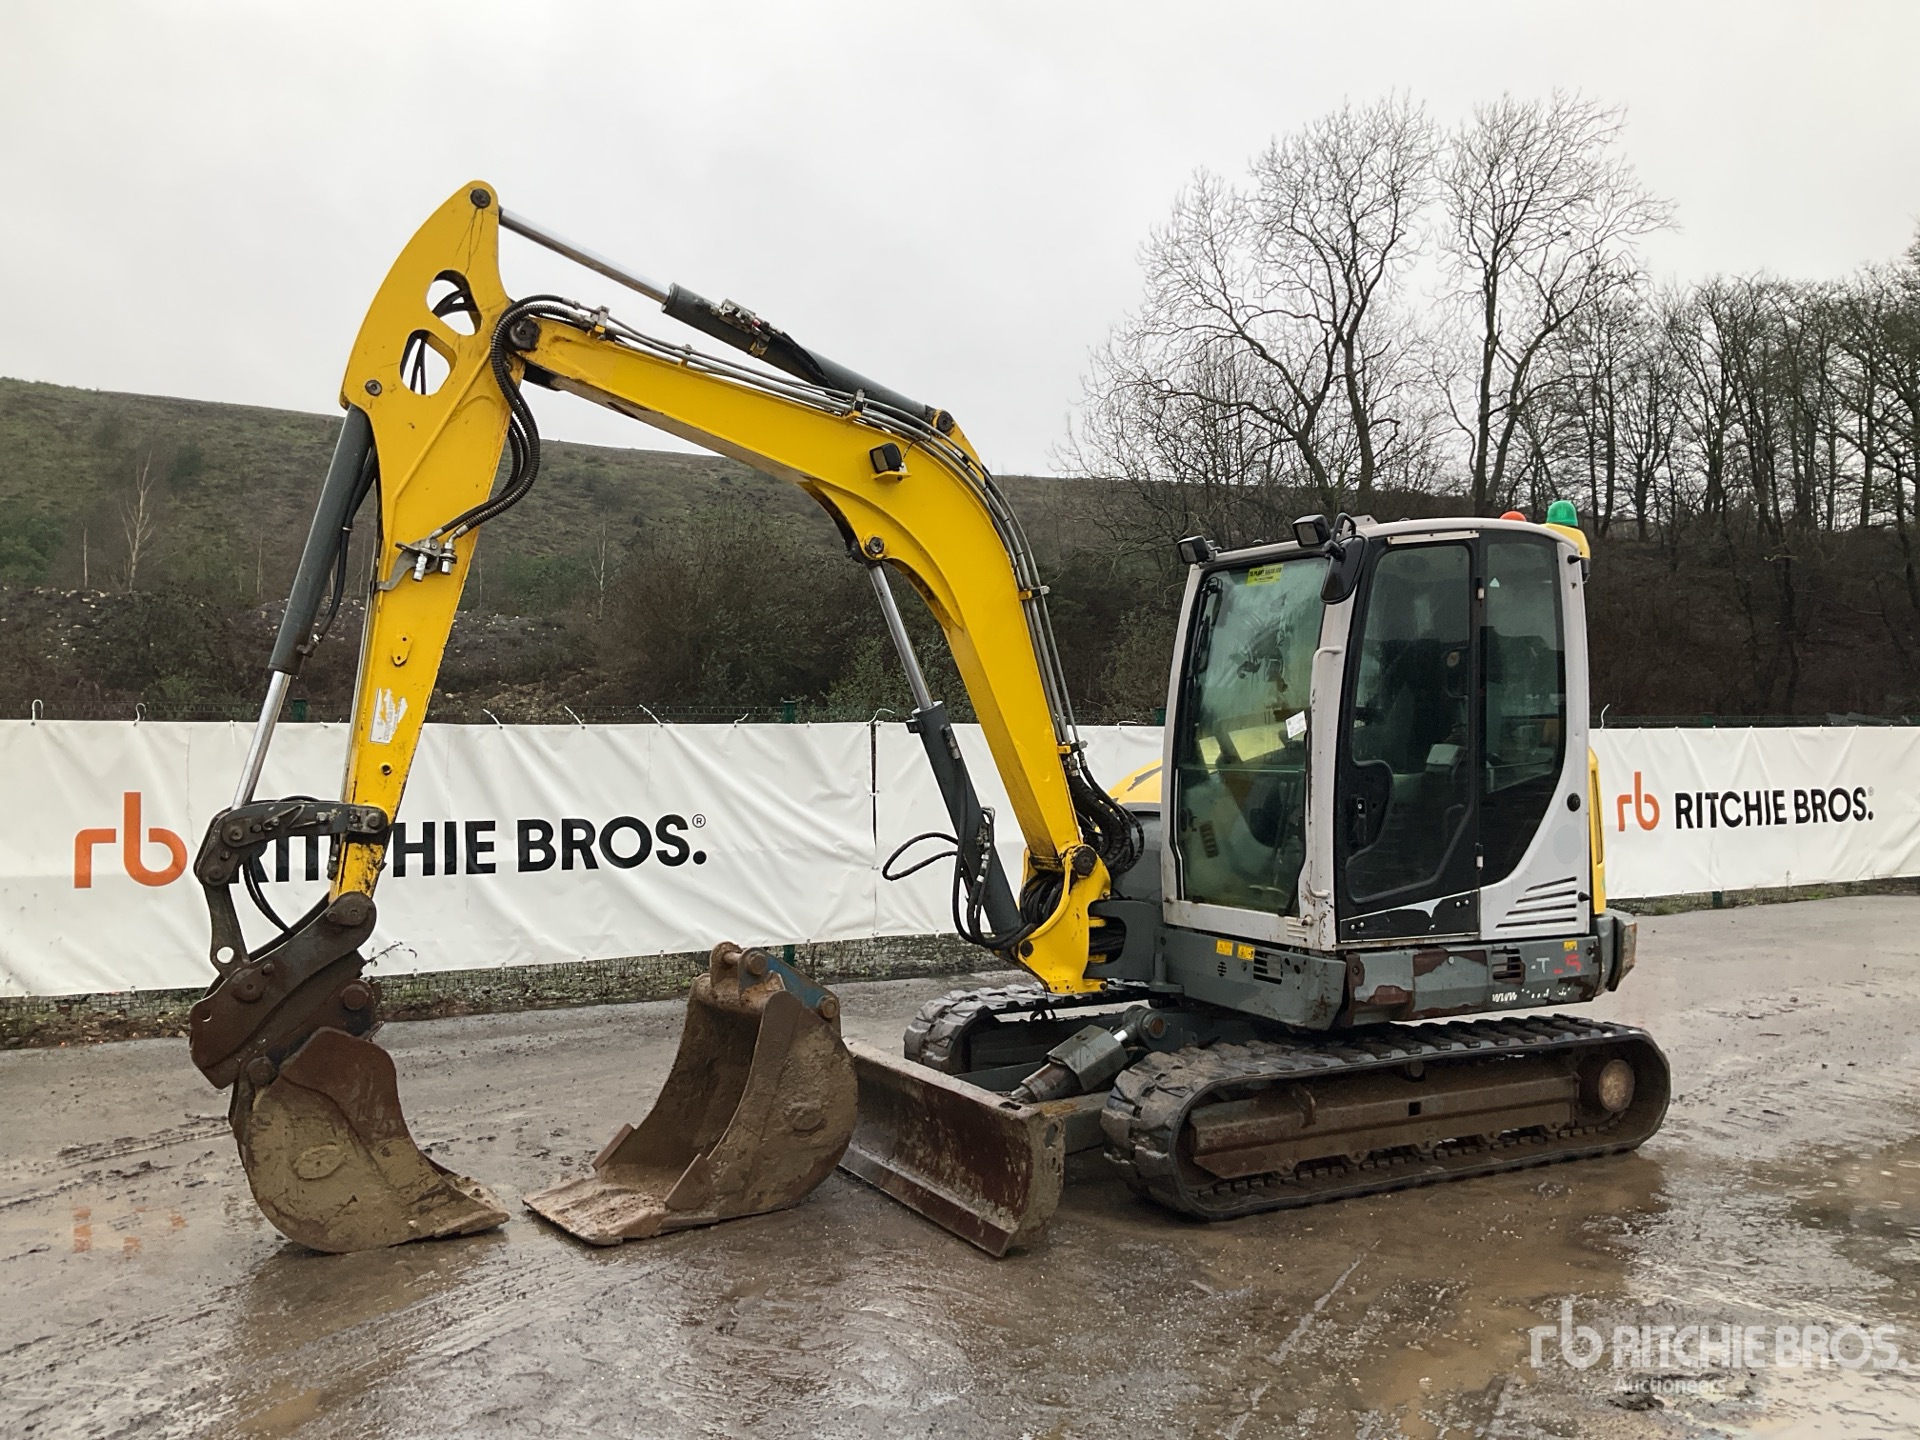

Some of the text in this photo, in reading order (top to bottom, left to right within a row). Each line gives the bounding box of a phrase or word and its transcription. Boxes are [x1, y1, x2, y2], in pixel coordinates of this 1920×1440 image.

[75, 793, 187, 888] rb
[1617, 771, 1660, 832] rb
[1675, 789, 1788, 830] RITCHIE
